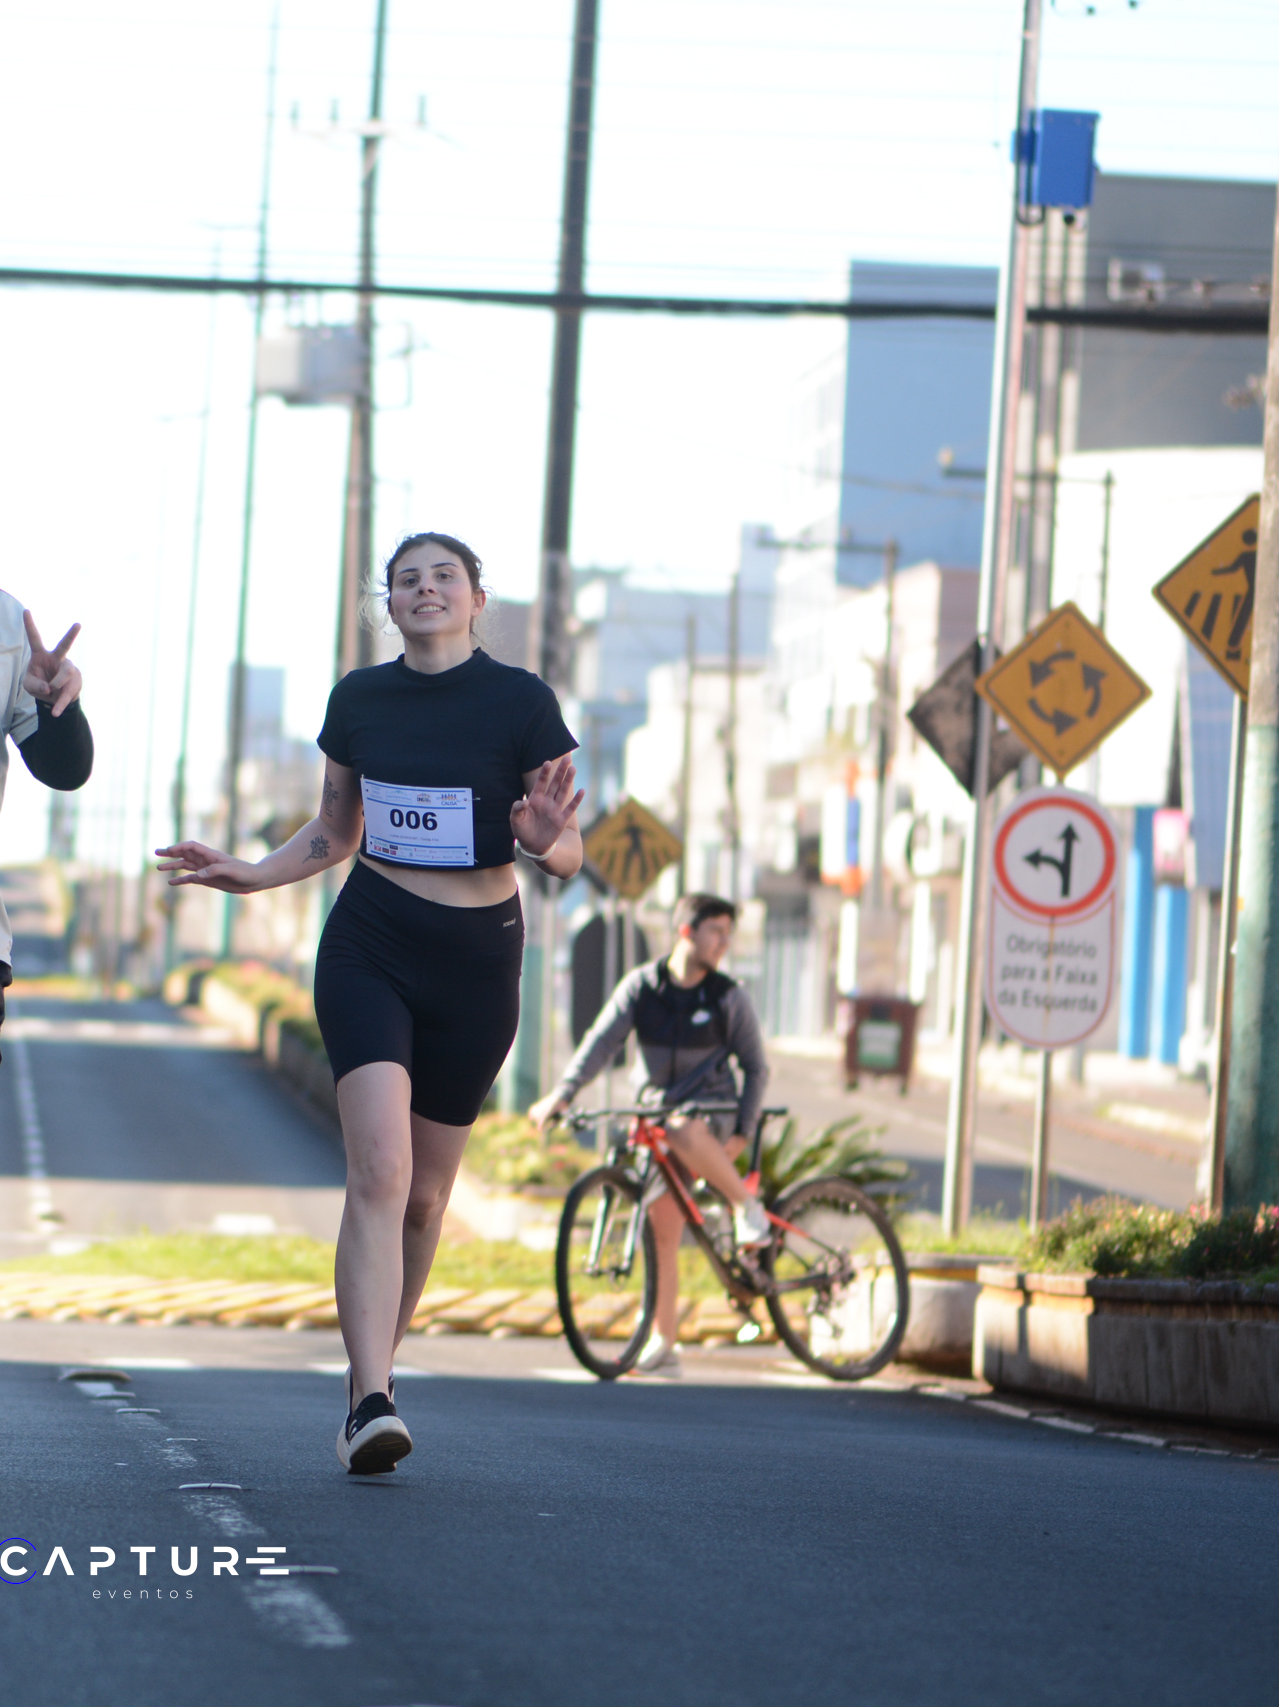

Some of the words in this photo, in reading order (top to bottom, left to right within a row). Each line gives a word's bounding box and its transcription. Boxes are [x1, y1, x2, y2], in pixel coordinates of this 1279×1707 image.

[389, 808, 438, 831] 006
[1005, 933, 1098, 960] Obrigatório
[1001, 964, 1037, 982] para
[1055, 964, 1098, 985] Faixa
[998, 988, 1018, 1007] da
[1022, 988, 1098, 1013] Esquerda
